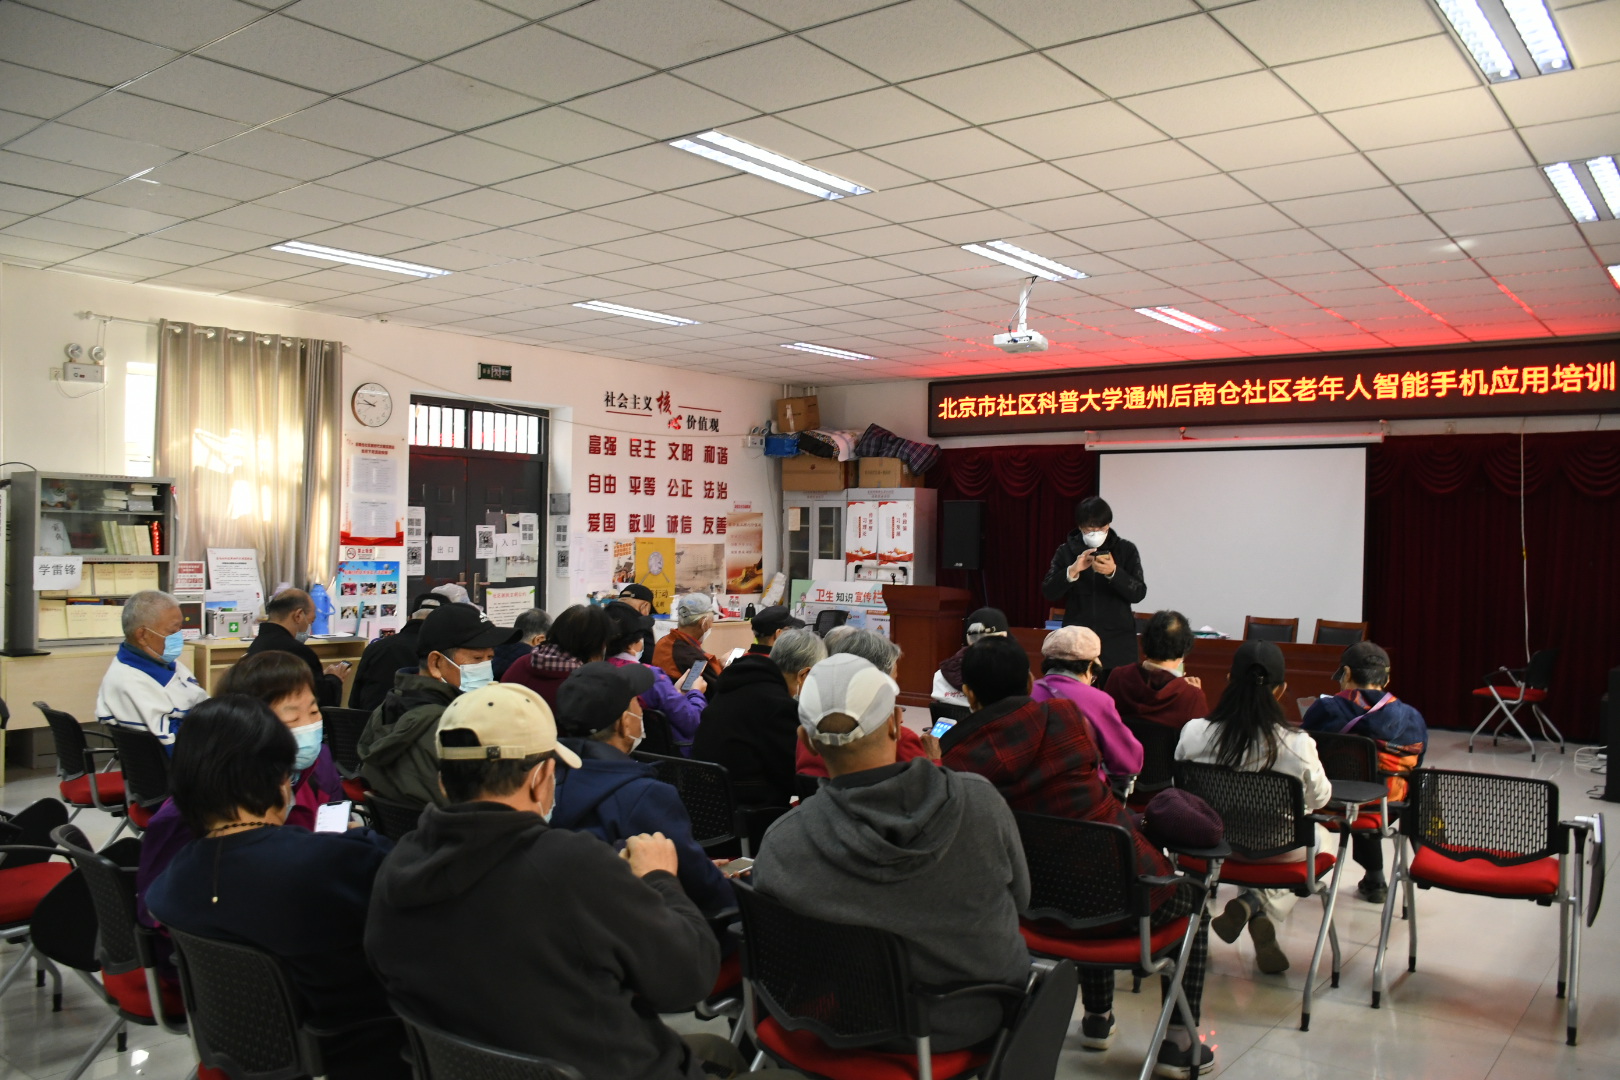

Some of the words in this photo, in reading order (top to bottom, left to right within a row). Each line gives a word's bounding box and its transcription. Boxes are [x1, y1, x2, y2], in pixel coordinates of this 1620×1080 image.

[938, 360, 1616, 420] 北京市社区科普大学通州后南仓社区老年人智能手机应用培训
[604, 391, 653, 411] 社会主义
[686, 415, 720, 432] 价值观
[588, 435, 617, 456] 富强
[629, 438, 656, 459] 民主
[668, 442, 693, 462] 文明
[703, 445, 728, 465] 和谐
[588, 474, 616, 494] 自由
[629, 476, 656, 496] 平等
[667, 479, 693, 498] 公正
[703, 481, 728, 500] 法治
[588, 513, 616, 533] 爱国
[629, 513, 655, 533] 敬业
[667, 515, 692, 534] 诚信
[703, 516, 727, 535] 友善
[437, 545, 454, 554] 出口
[501, 539, 518, 547] 入口
[39, 564, 76, 576] 学雷锋
[815, 588, 883, 604] 卫生知识宣传栏
